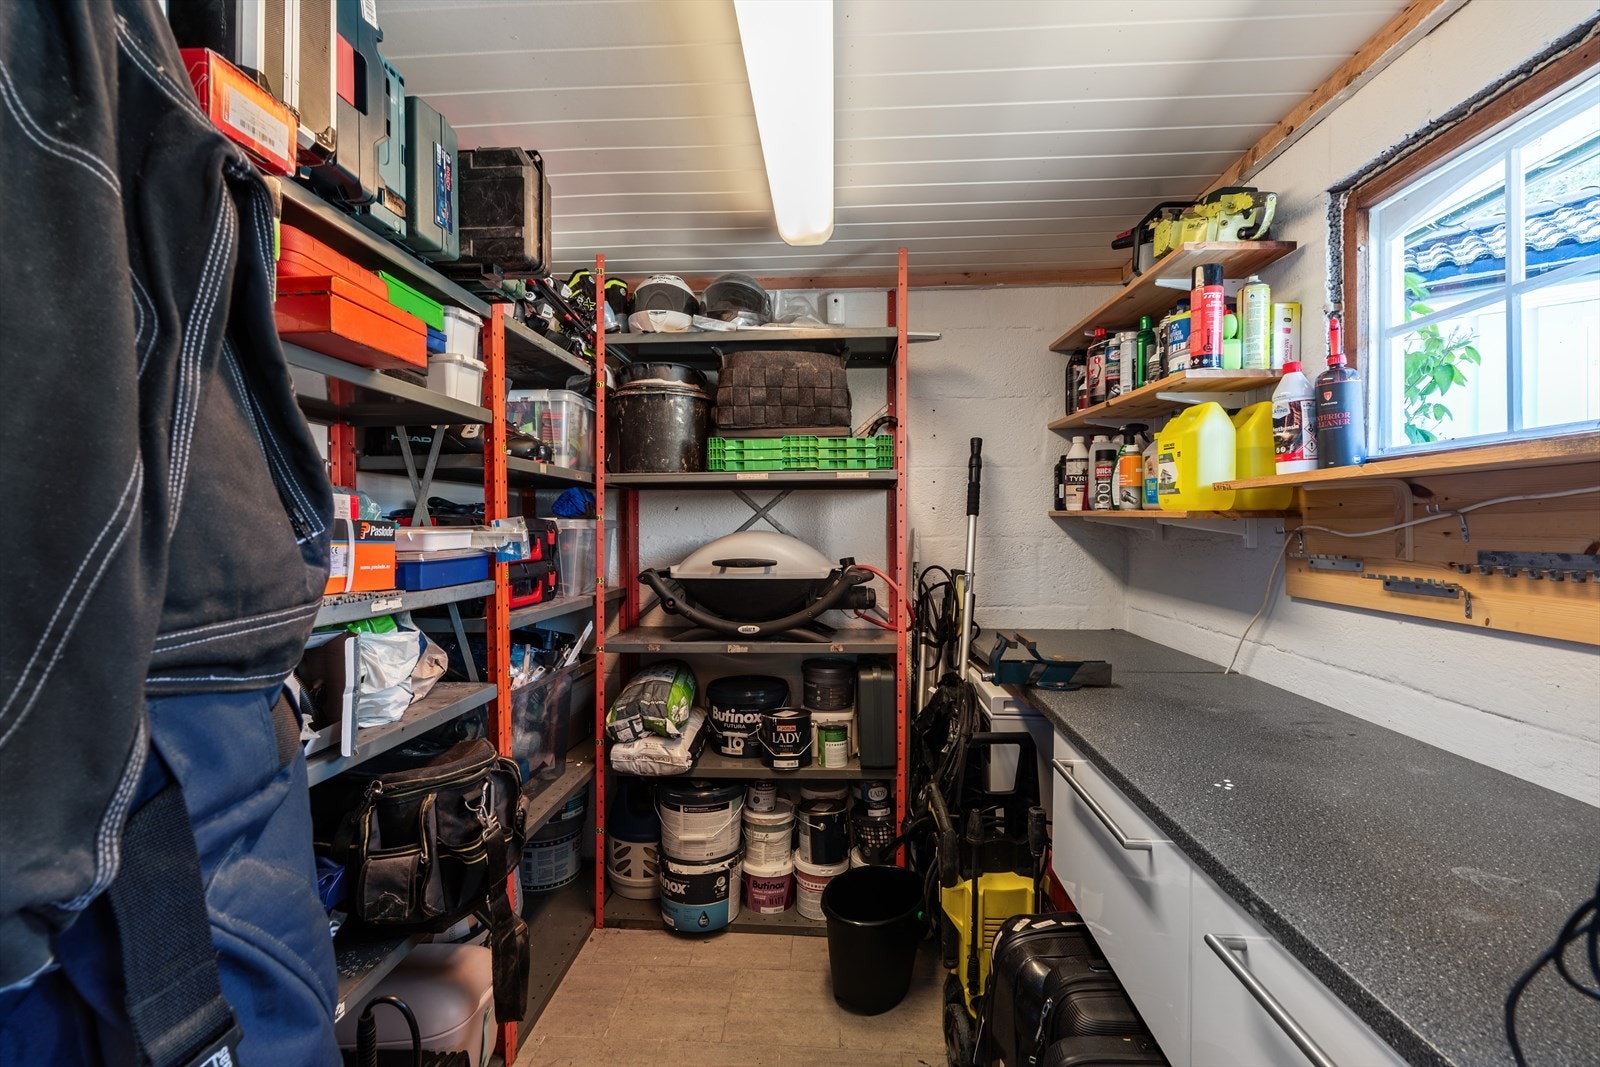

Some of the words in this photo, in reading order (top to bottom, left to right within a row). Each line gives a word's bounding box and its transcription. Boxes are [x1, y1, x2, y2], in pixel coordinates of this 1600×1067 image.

[370, 526, 394, 537] Paslode
[712, 705, 762, 724] Butinox
[772, 732, 802, 744] LADY
[870, 789, 885, 798] LADY
[752, 879, 785, 890] Butinox
